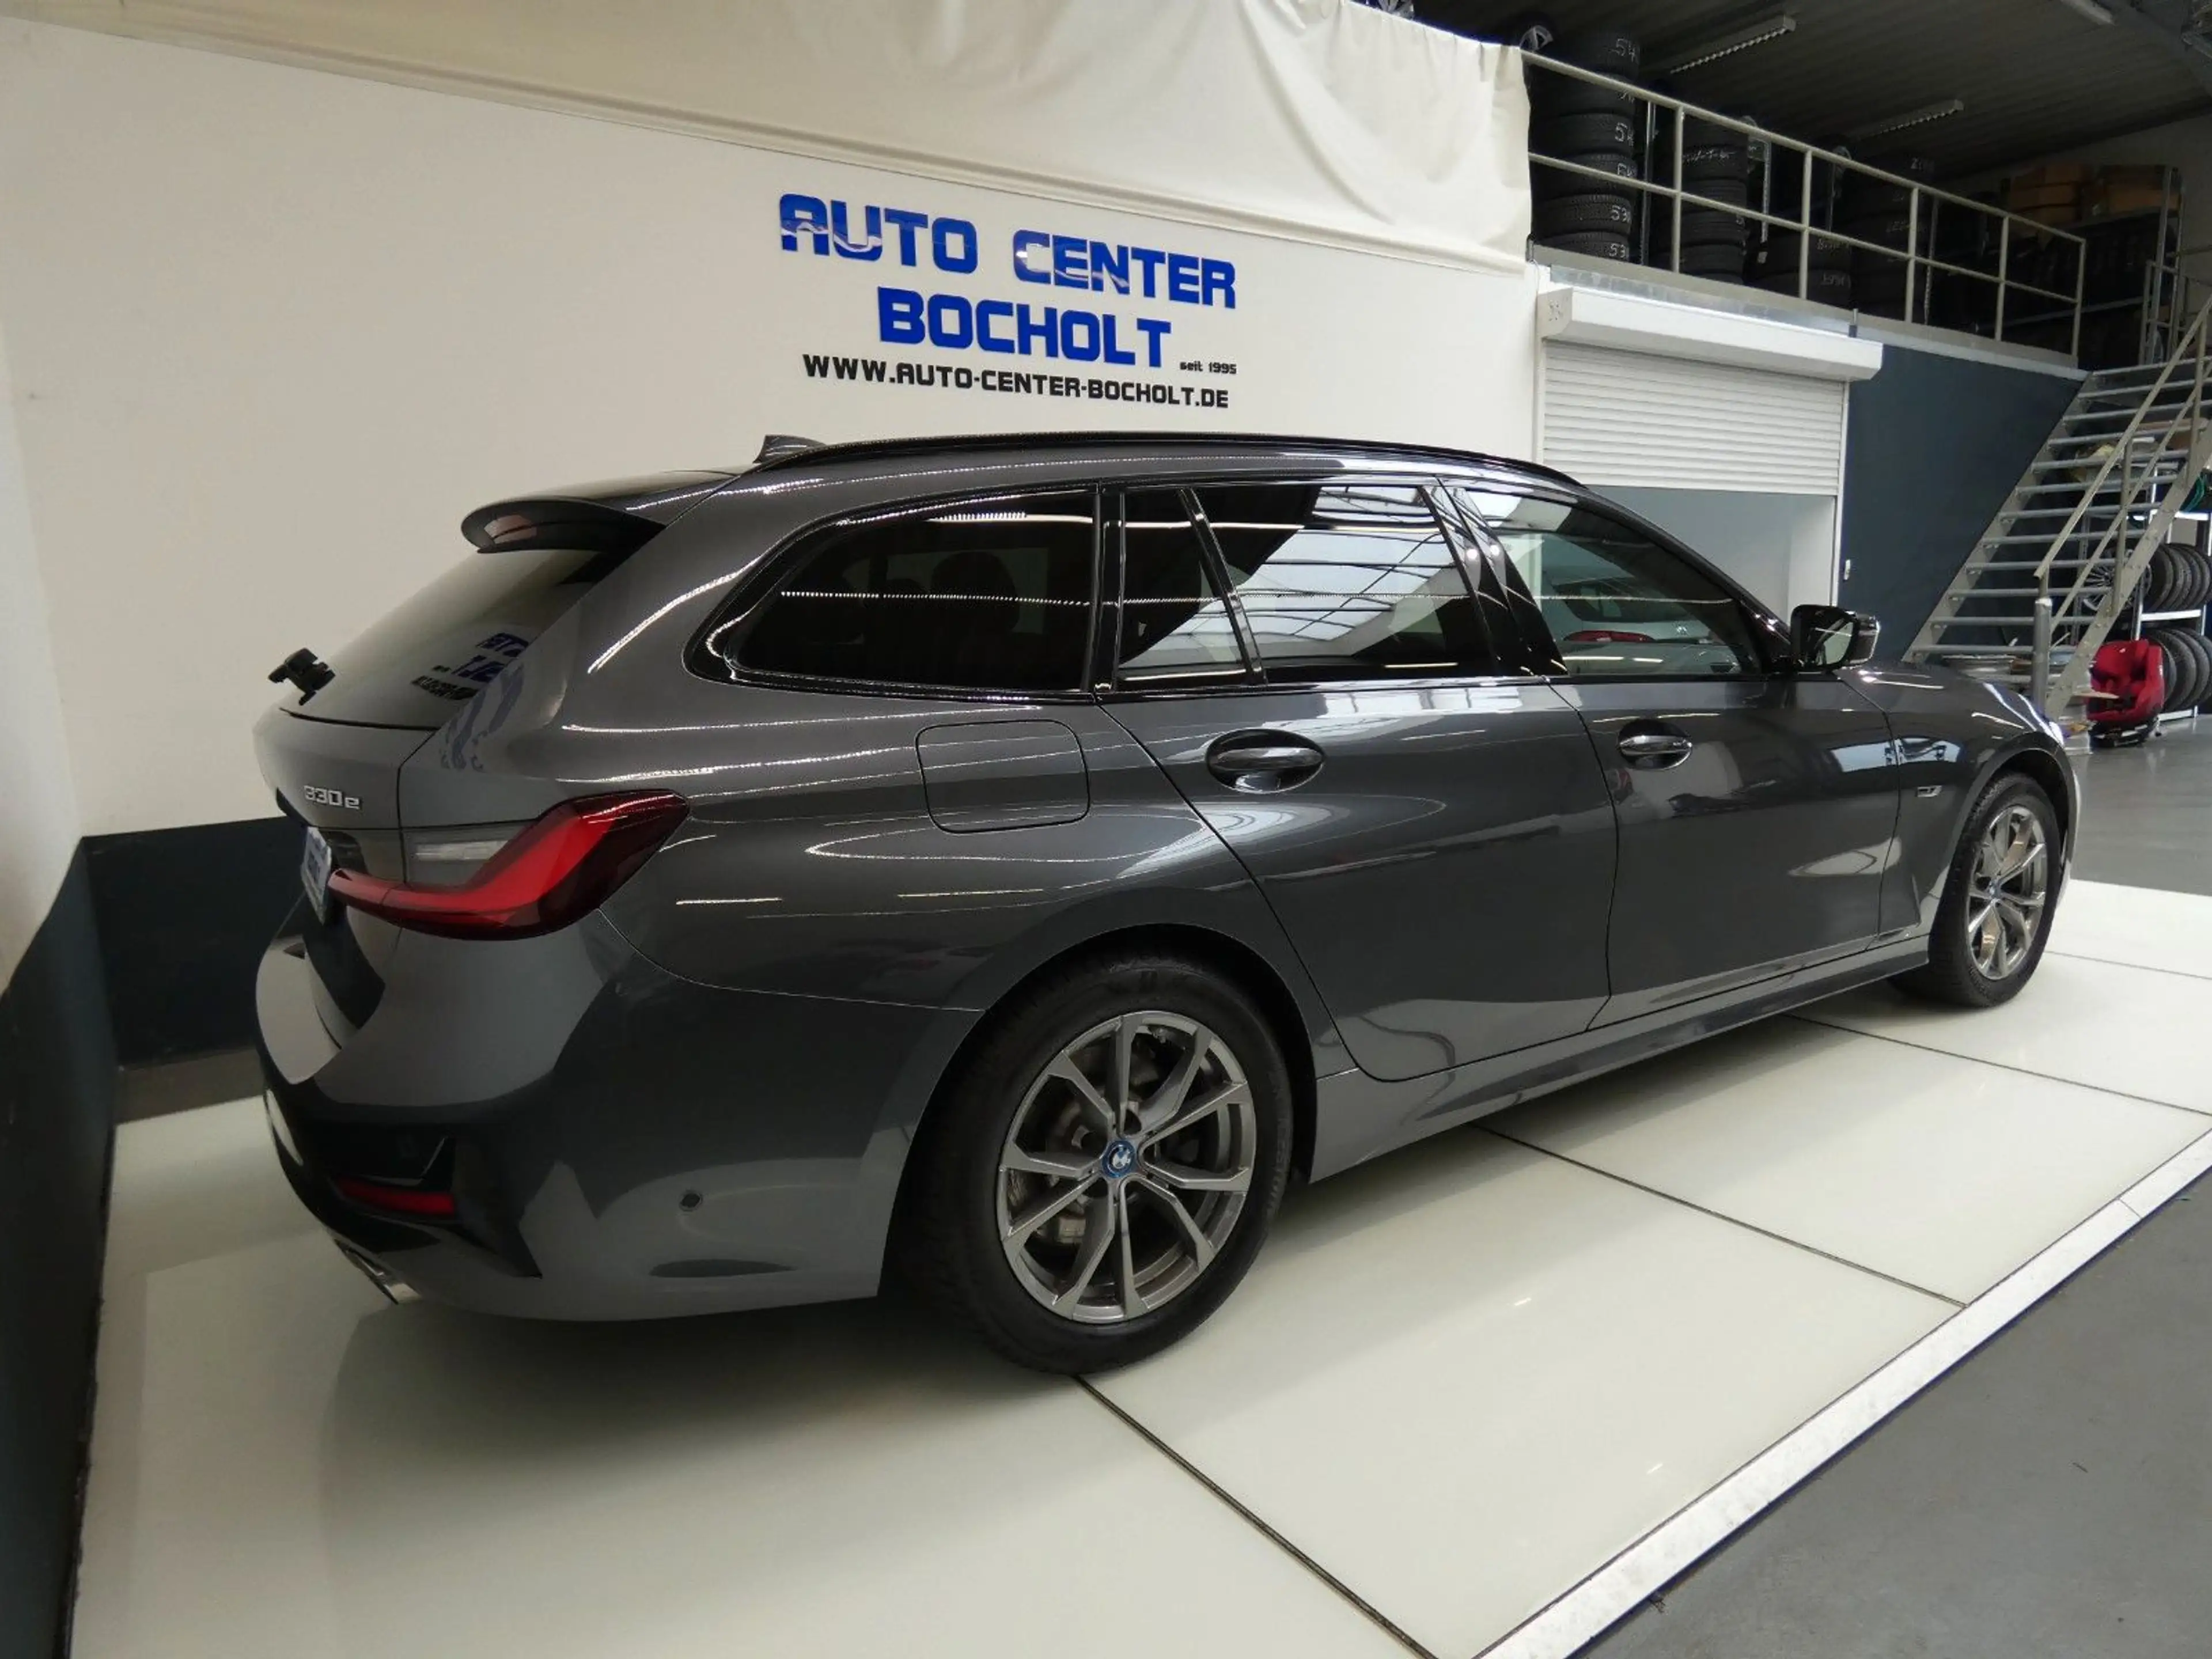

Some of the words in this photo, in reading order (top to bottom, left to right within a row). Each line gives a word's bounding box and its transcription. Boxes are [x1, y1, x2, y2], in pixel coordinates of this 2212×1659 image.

[779, 193, 978, 274] AUTO
[1013, 229, 1236, 309] CENTER
[877, 286, 1172, 368] BOCHOLT
[802, 353, 1229, 408] WWW.AUTO-CENTER-BOCHOLT.DE
[1180, 360, 1203, 372] seit
[1208, 362, 1237, 374] 1995
